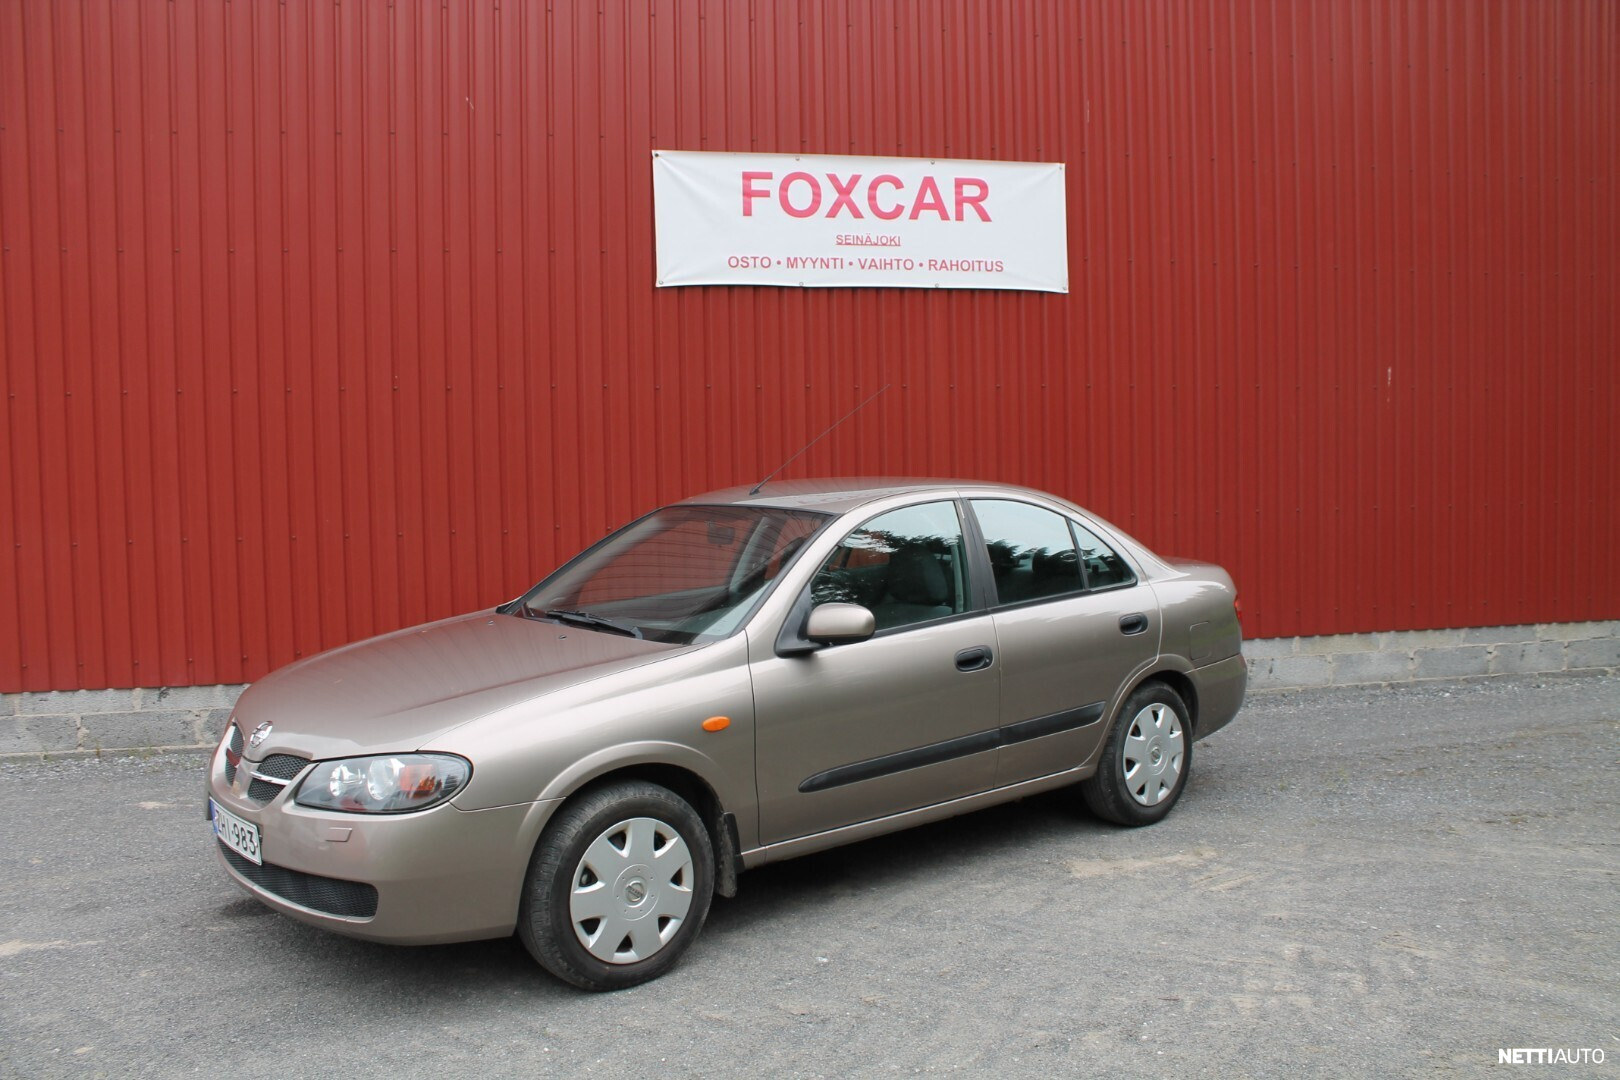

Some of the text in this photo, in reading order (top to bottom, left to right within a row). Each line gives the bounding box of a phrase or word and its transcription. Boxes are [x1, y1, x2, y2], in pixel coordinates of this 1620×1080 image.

[742, 171, 992, 223] FOXCAR
[837, 234, 901, 246] SEINÄJOKI
[728, 256, 1004, 273] OSTO MYYNTI VAIHTO RAHOITUS
